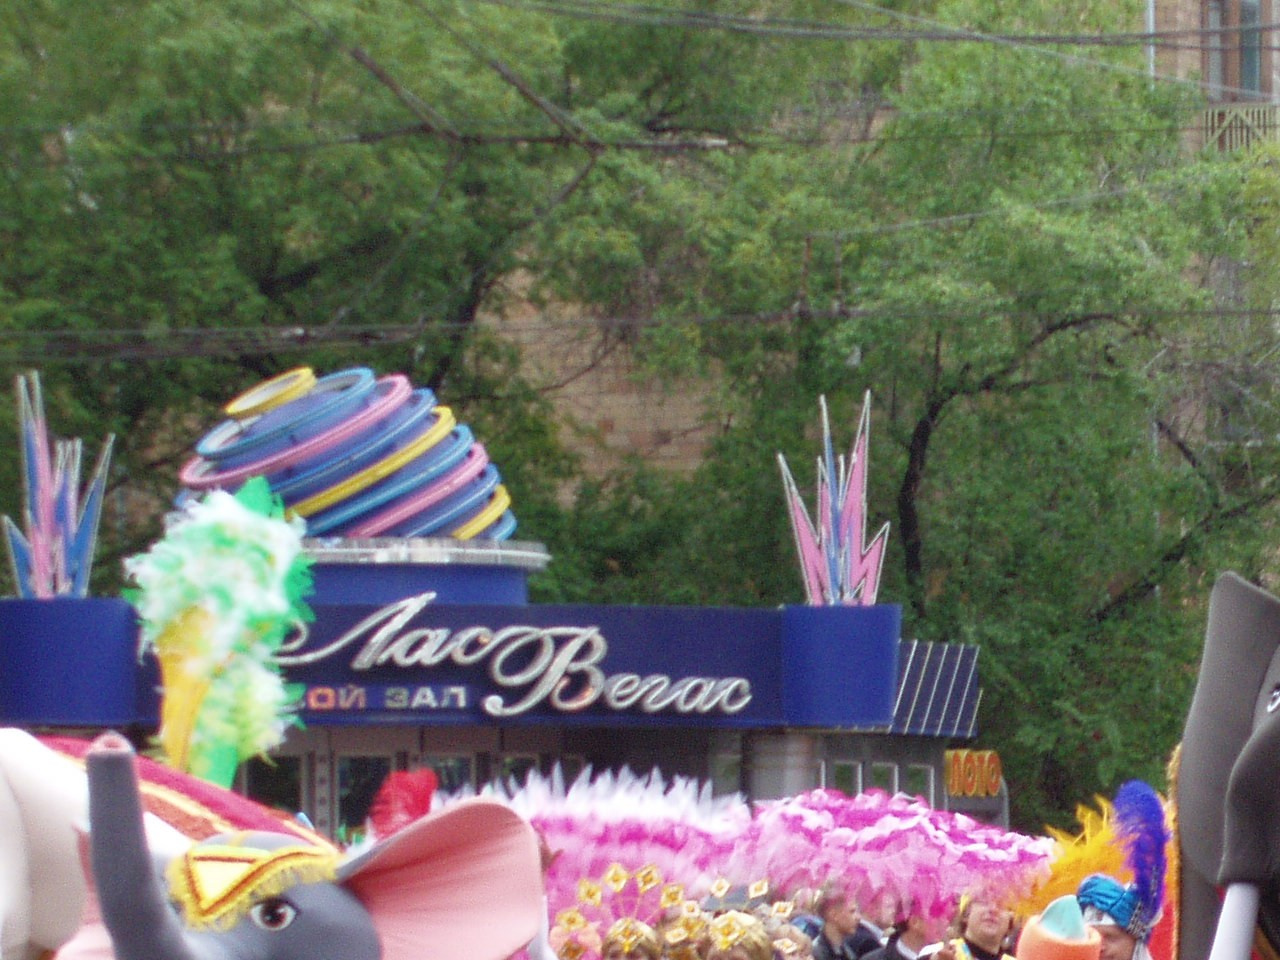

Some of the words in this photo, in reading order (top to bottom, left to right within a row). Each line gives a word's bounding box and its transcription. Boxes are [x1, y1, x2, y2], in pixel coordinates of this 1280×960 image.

[274, 590, 490, 670] Лас
[484, 624, 753, 717] Вегас
[384, 685, 468, 710] ЗАЛ
